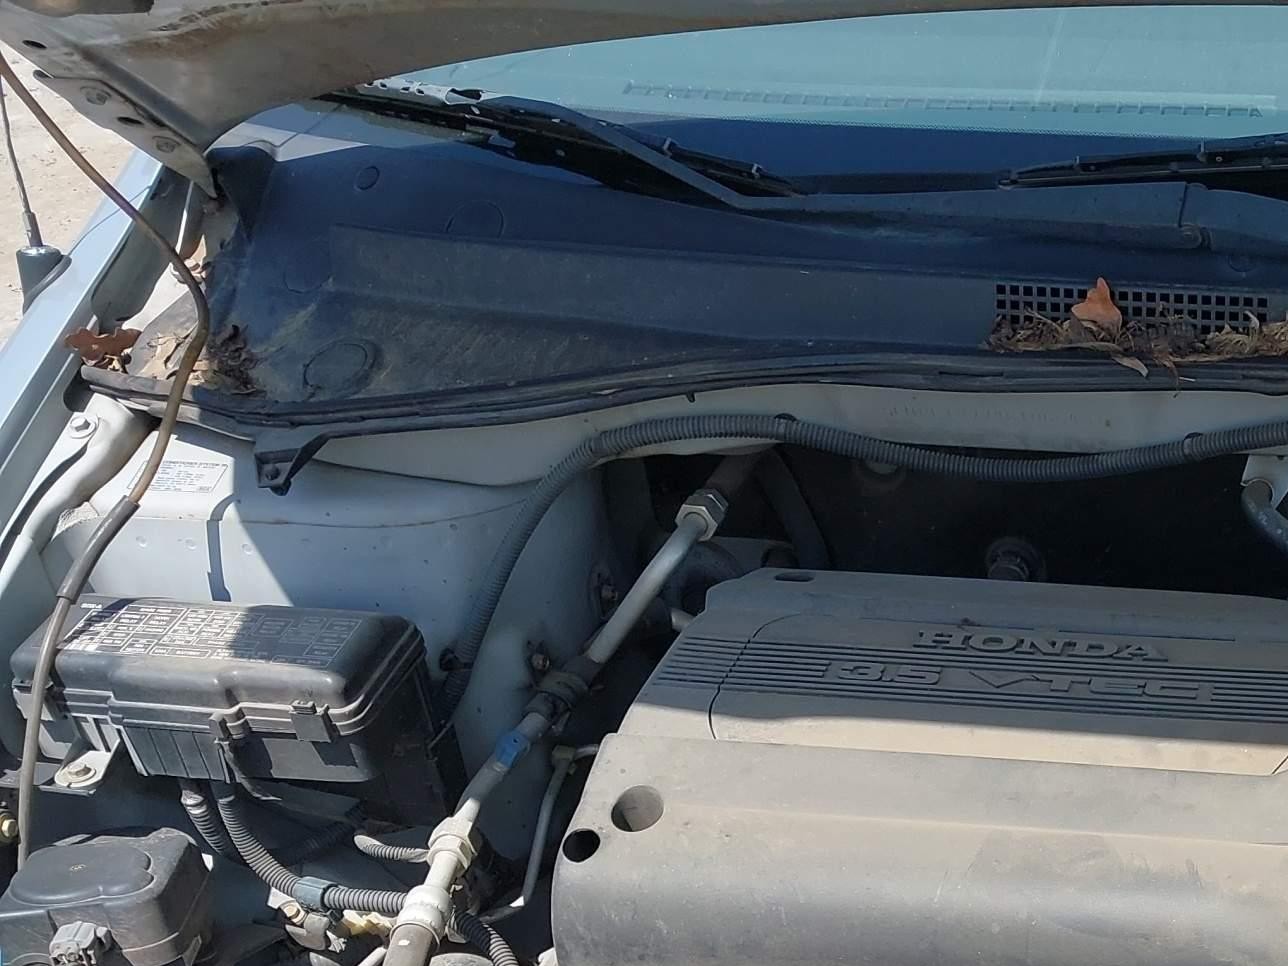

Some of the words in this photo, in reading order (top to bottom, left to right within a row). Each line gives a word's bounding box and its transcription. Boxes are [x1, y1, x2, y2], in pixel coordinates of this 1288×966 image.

[912, 629, 1169, 662] HONDA
[837, 660, 942, 686] 3.5
[968, 670, 1200, 700] VTEC
